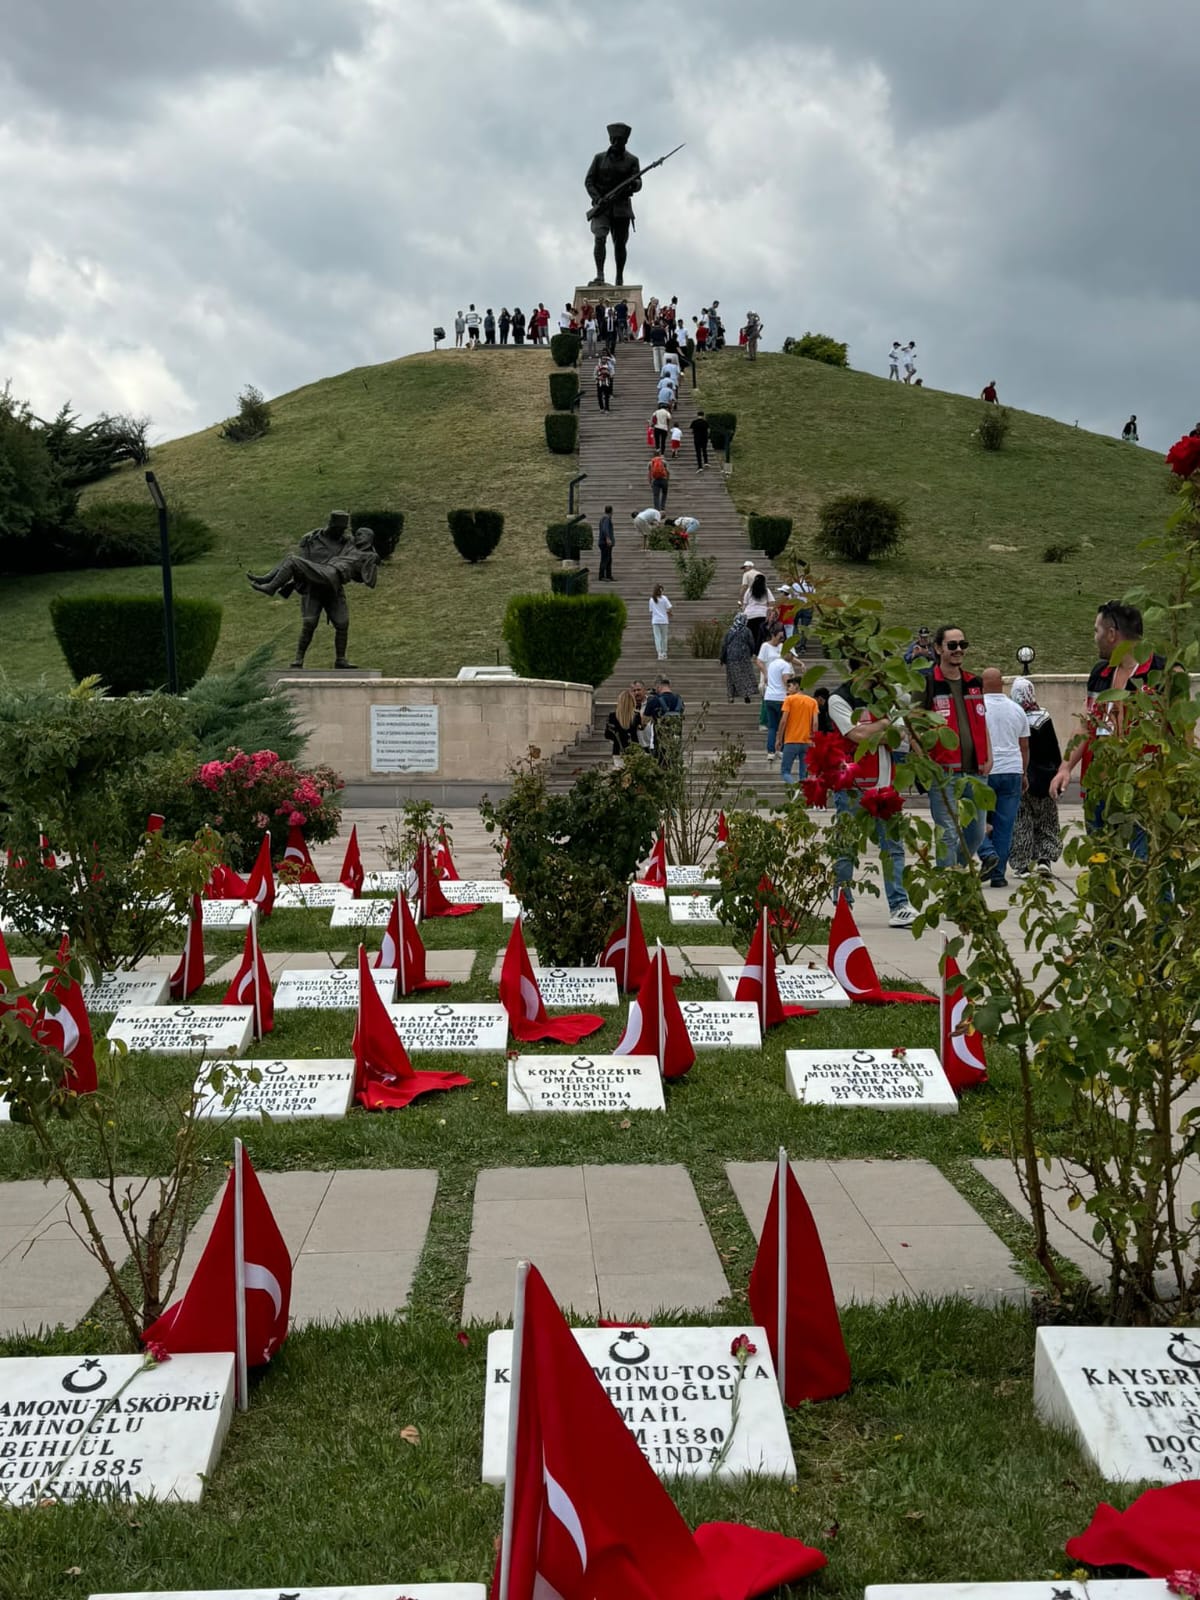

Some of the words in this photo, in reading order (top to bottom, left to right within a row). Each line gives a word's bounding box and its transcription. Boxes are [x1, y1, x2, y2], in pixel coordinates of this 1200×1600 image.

[115, 1016, 247, 1024] MALATYA-HEKİMHAN
[812, 1063, 926, 1071] KONYA-BOZKIR
[528, 1068, 643, 1076] KONYA-BOZKIR
[543, 1075, 625, 1084] ÖMEROĞLU
[847, 1077, 900, 1085] MURAT
[493, 1364, 770, 1384] KMONU-TOSYA
[0, 1435, 114, 1459] BEHLÜL
[1162, 1455, 1194, 1474] 43
